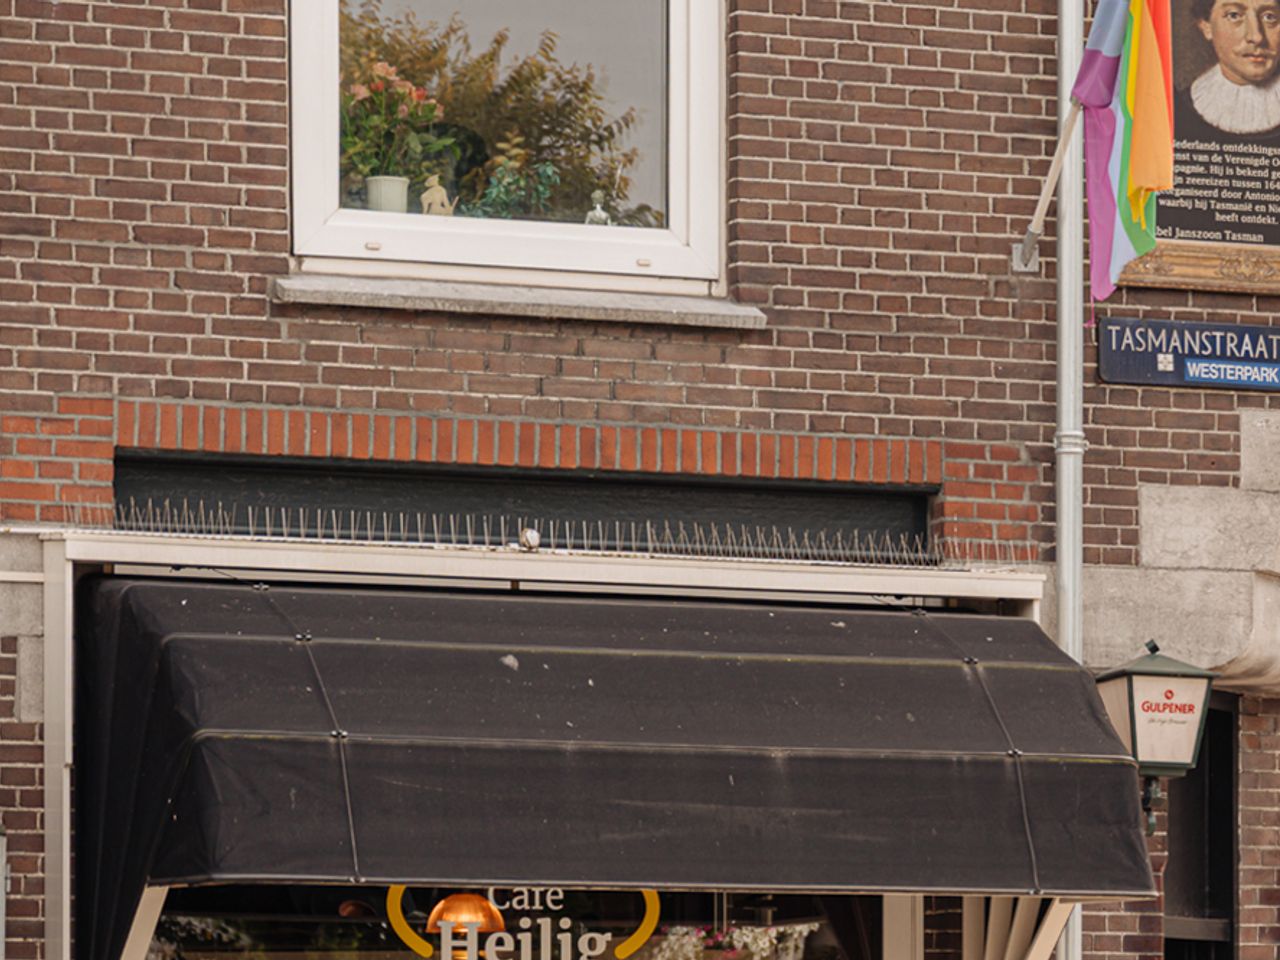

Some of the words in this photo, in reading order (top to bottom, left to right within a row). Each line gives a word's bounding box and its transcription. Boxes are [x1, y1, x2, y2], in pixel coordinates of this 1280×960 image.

[1174, 139, 1220, 151] ederlands
[1211, 154, 1222, 163] de
[1224, 155, 1270, 167] Verenigde
[1174, 164, 1208, 174] pagnie.
[1210, 165, 1224, 177] Hij
[1226, 166, 1234, 176] is
[1236, 167, 1269, 178] bekend
[1186, 178, 1230, 187] zeereizen
[1232, 180, 1262, 189] tussen
[1221, 190, 1242, 199] door
[1244, 191, 1280, 201] Antonio
[1158, 198, 1193, 210] waarbij
[1194, 198, 1208, 210] hij
[1254, 204, 1267, 212] en
[1215, 211, 1239, 222] heeft
[1240, 215, 1279, 225] ontdekt.
[1156, 225, 1173, 236] bel
[1175, 226, 1222, 240] Janszoon
[1224, 230, 1264, 243] Tasman
[1186, 362, 1280, 383] WESTERPARK
[1140, 700, 1195, 714] GULPENER
